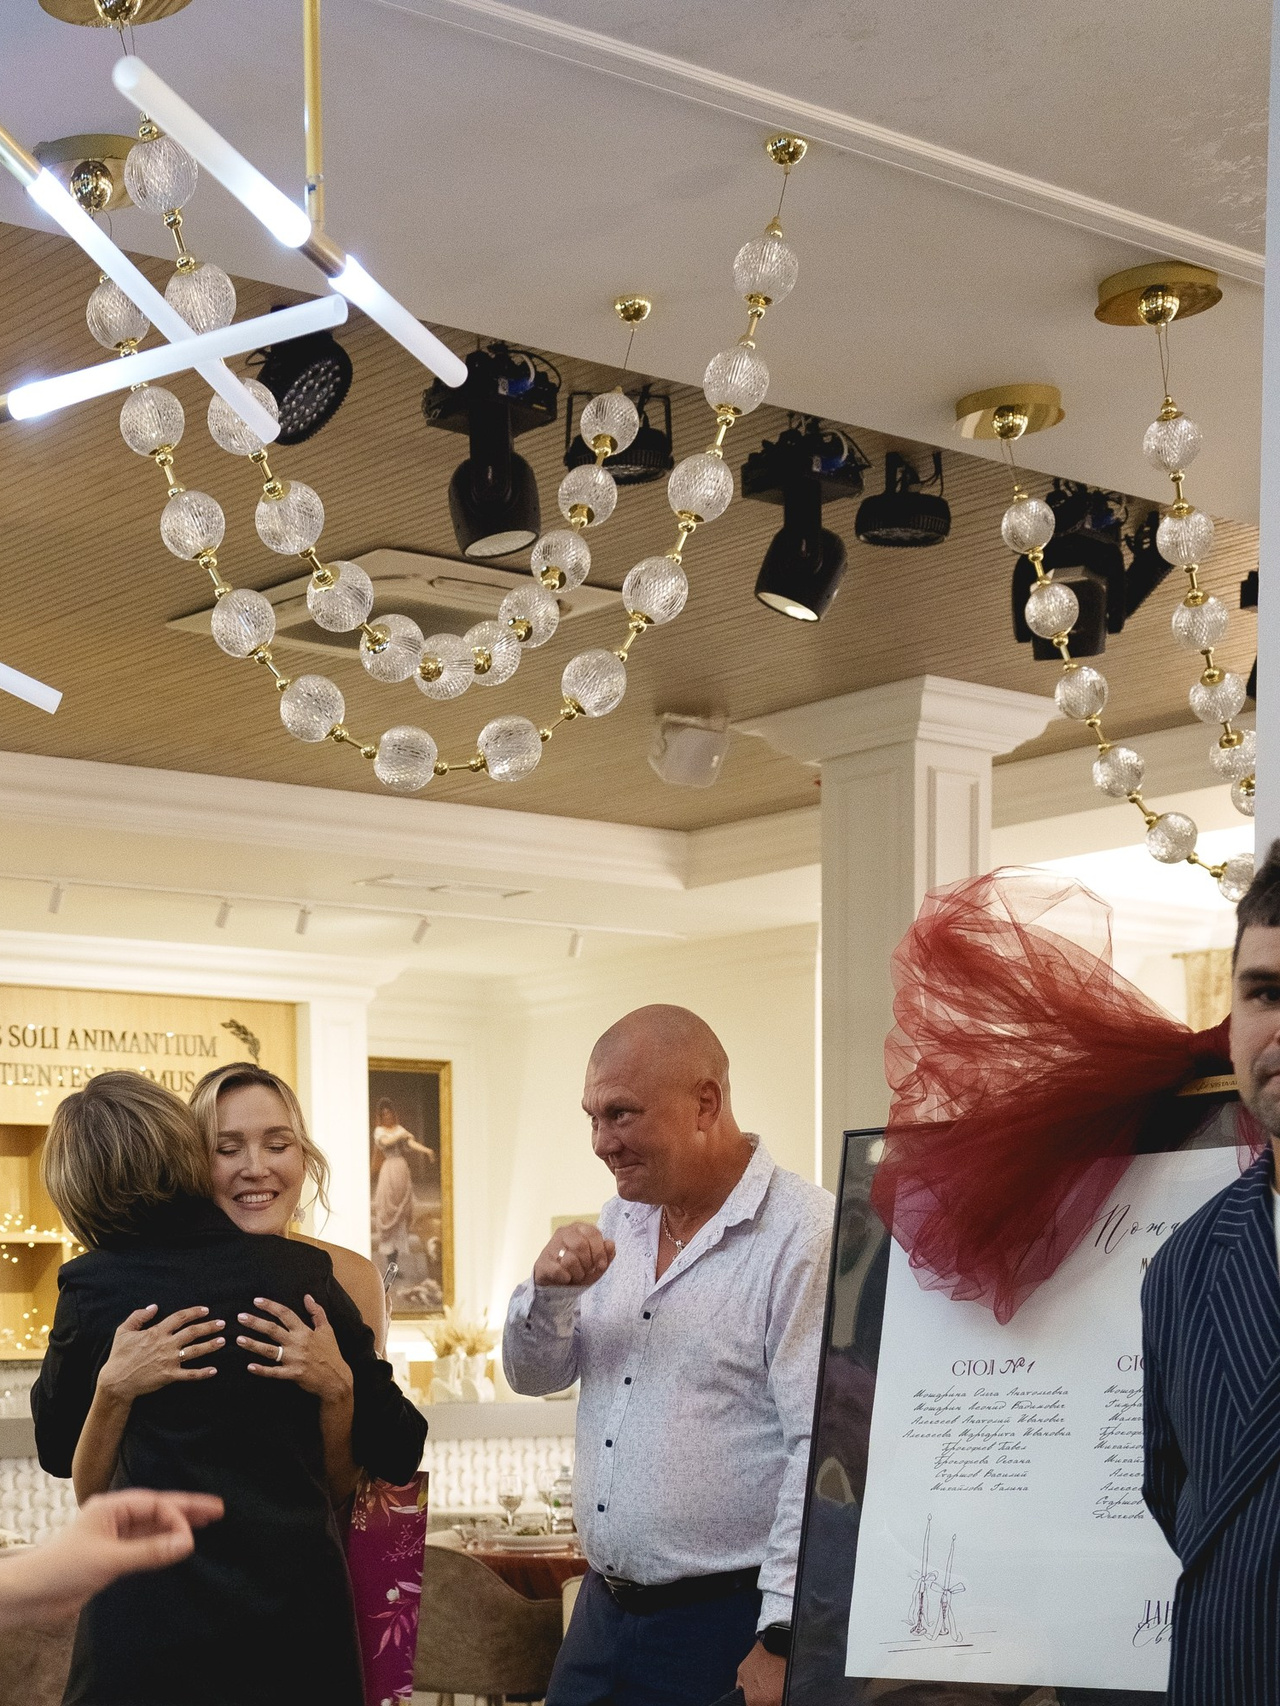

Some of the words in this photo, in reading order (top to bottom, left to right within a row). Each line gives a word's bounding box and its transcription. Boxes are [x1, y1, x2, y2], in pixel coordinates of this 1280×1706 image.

[8, 1024, 59, 1049] SOLI
[66, 1028, 218, 1058] ANIMANTIUM
[951, 1359, 995, 1377] СТОЛ
[973, 1387, 1000, 1397] Ольга
[1006, 1386, 1069, 1397] Анатольевна
[968, 1400, 1007, 1410] Леонид
[1011, 1400, 1065, 1410] Вадимович
[911, 1415, 961, 1425] Алексеев
[961, 1414, 1011, 1424] Анатолий
[1017, 1413, 1065, 1423] Иванович
[902, 1428, 952, 1438] Алексеева
[1023, 1427, 1072, 1437] Ивановна
[997, 1441, 1027, 1451] Павел
[995, 1455, 1032, 1465] Оксана
[983, 1469, 1028, 1478] Василий
[990, 1482, 1029, 1492] Галина
